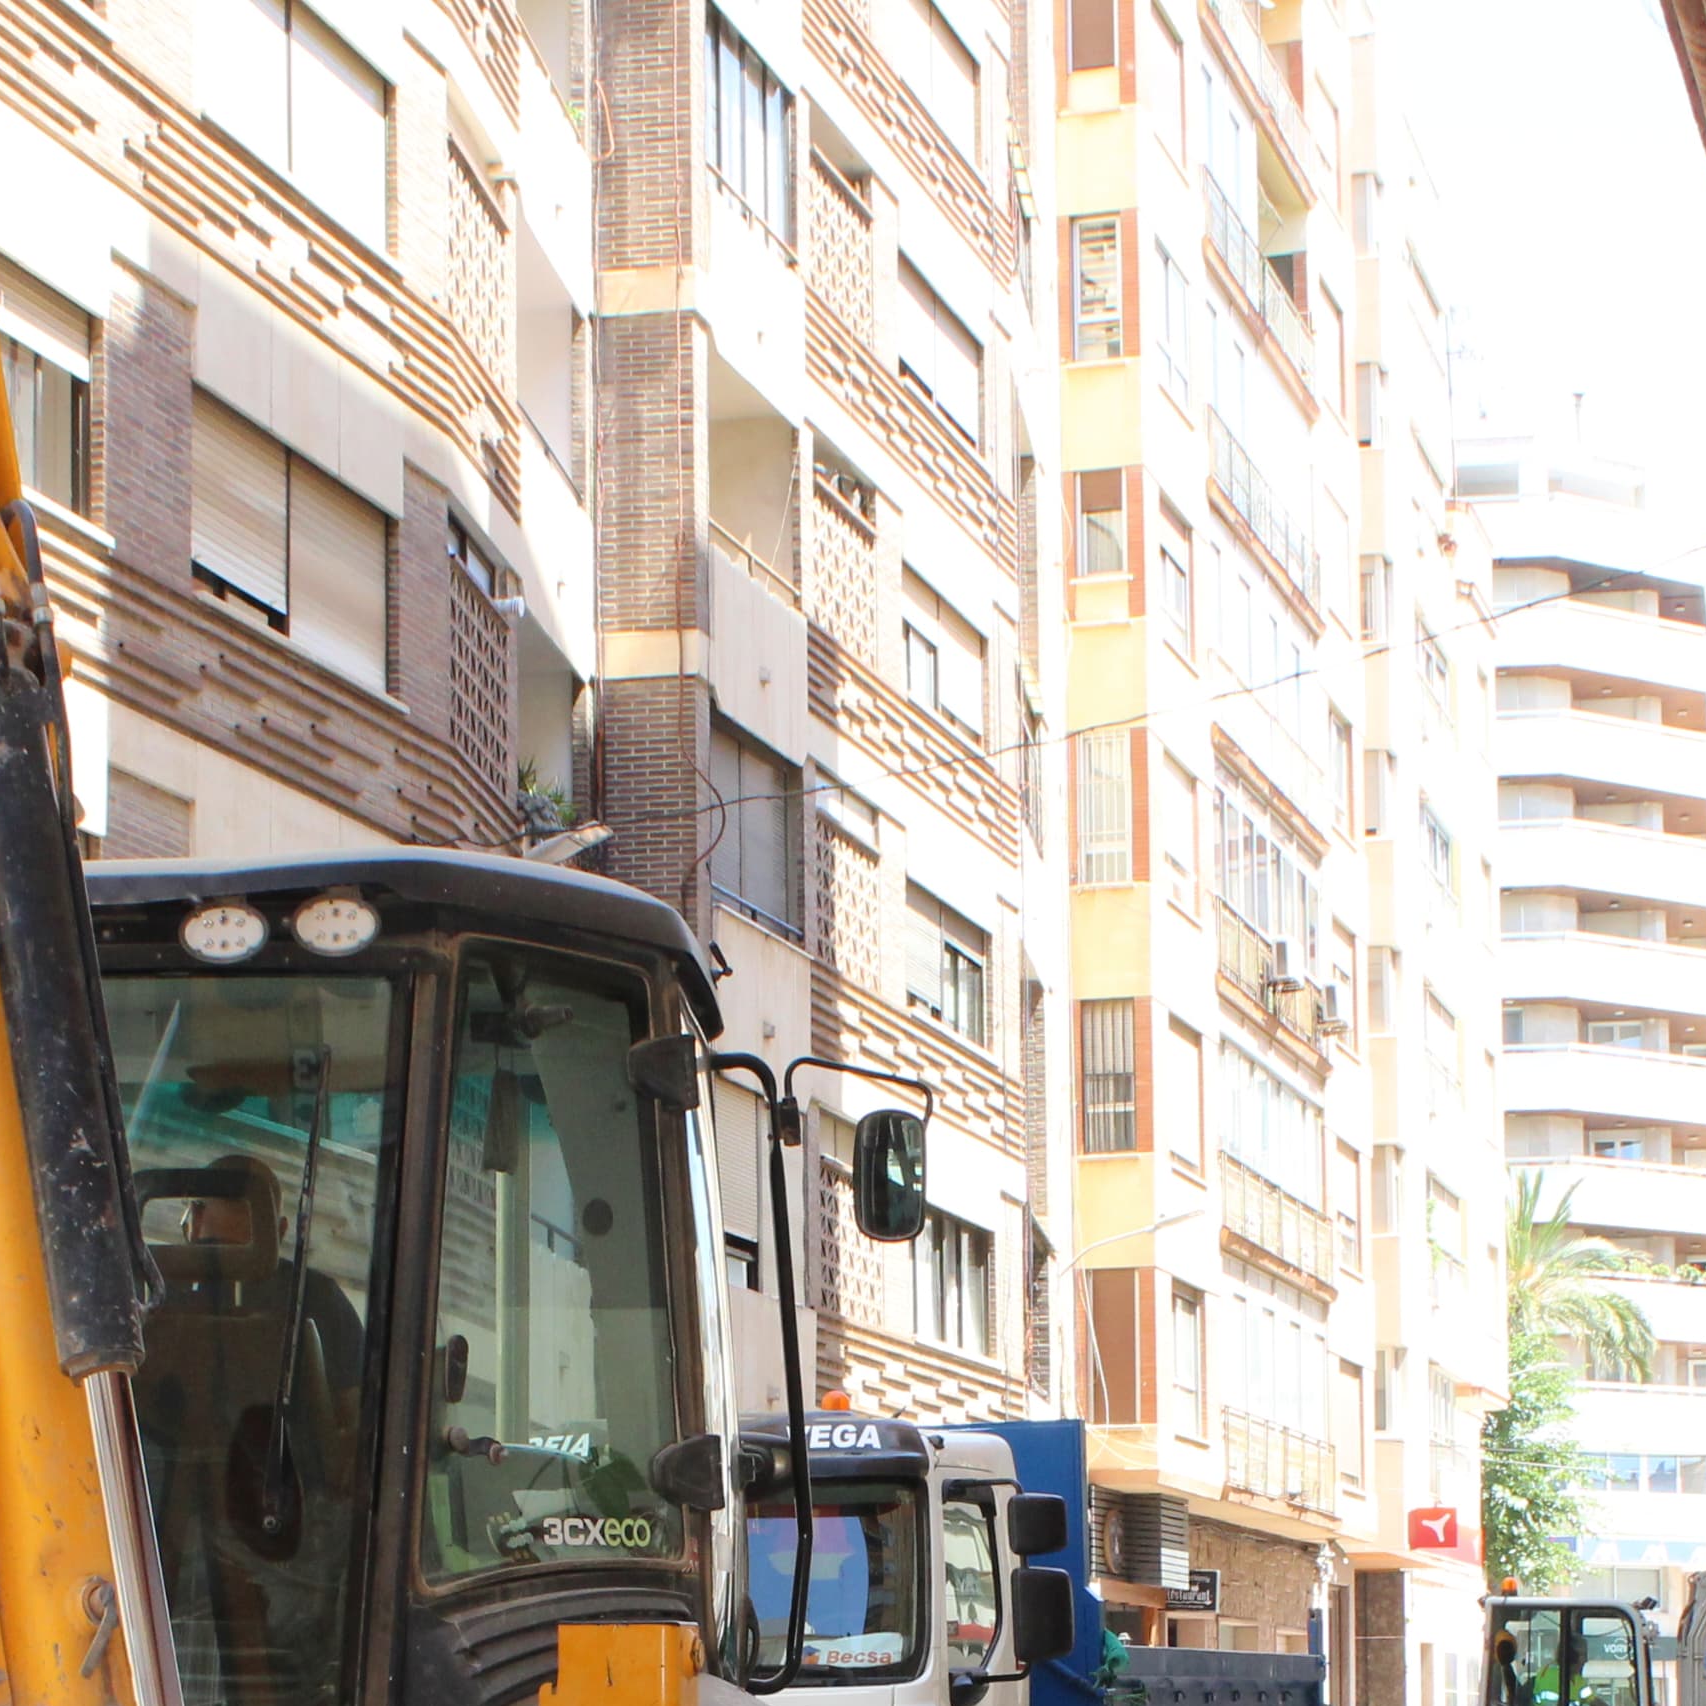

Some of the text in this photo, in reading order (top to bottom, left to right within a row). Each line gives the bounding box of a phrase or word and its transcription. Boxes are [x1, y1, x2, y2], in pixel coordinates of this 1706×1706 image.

[786, 1424, 881, 1449] EGA
[542, 1516, 651, 1547] 3CXeco
[826, 1650, 893, 1665] Becsa
